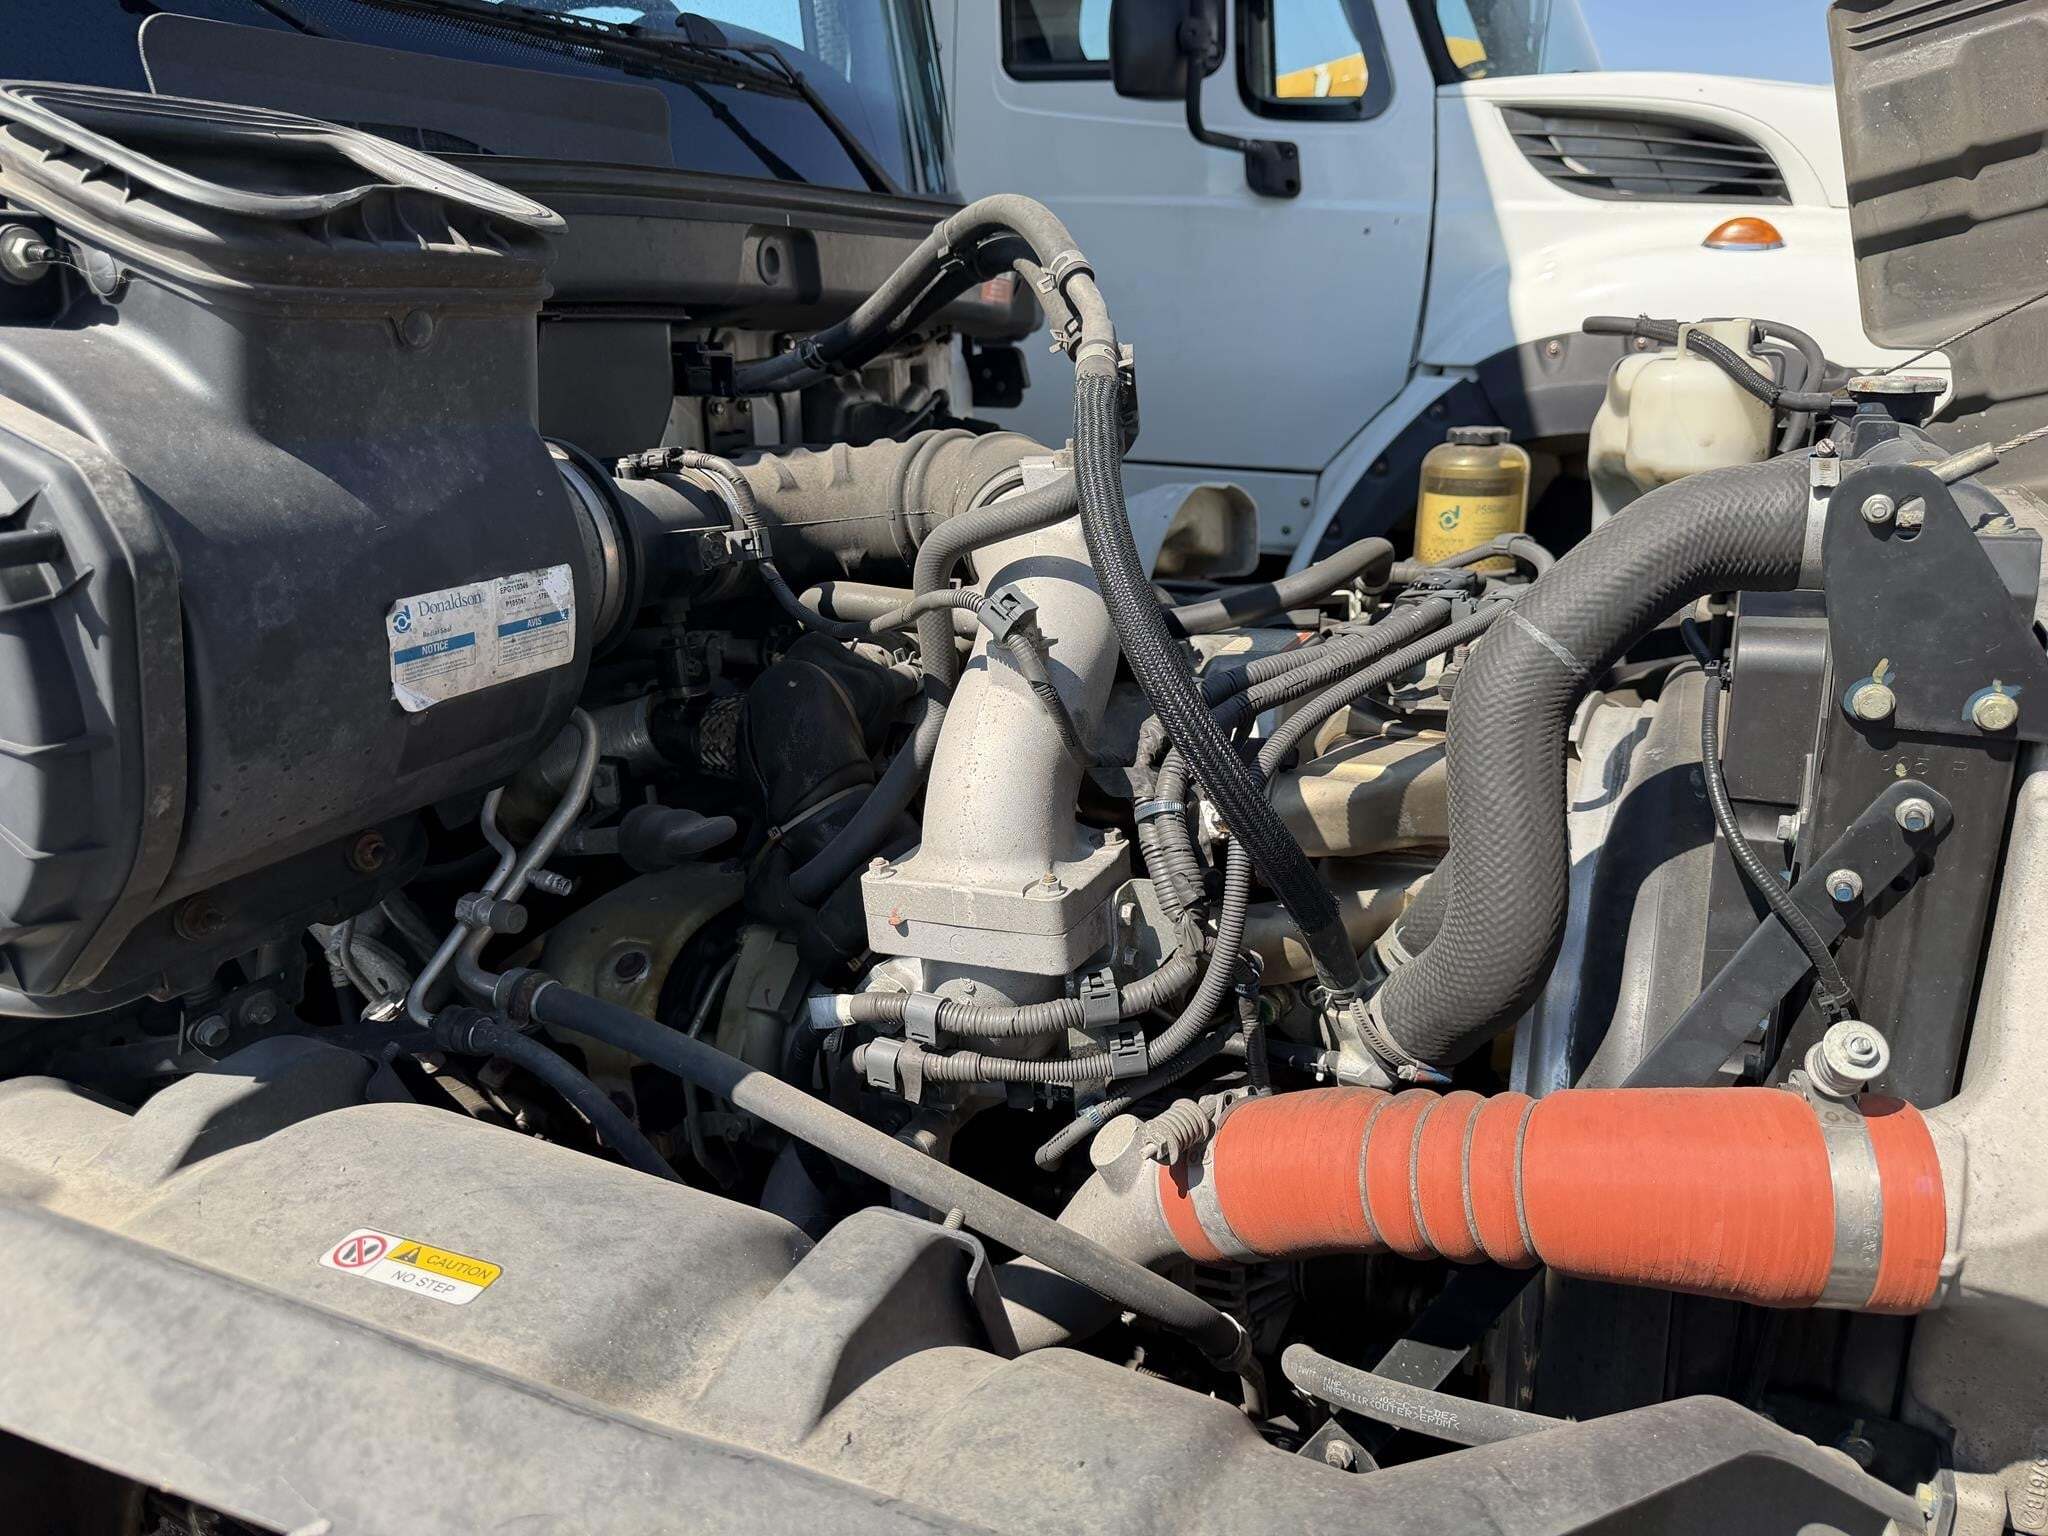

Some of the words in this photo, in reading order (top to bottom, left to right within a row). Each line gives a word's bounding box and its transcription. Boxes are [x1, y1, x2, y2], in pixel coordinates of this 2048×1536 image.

[417, 591, 482, 617] Donaldson
[527, 616, 542, 629] AVIS
[421, 640, 449, 656] NOTICE
[426, 1255, 493, 1280] CAUTION
[391, 1270, 415, 1283] NO
[415, 1275, 456, 1294] STEP
